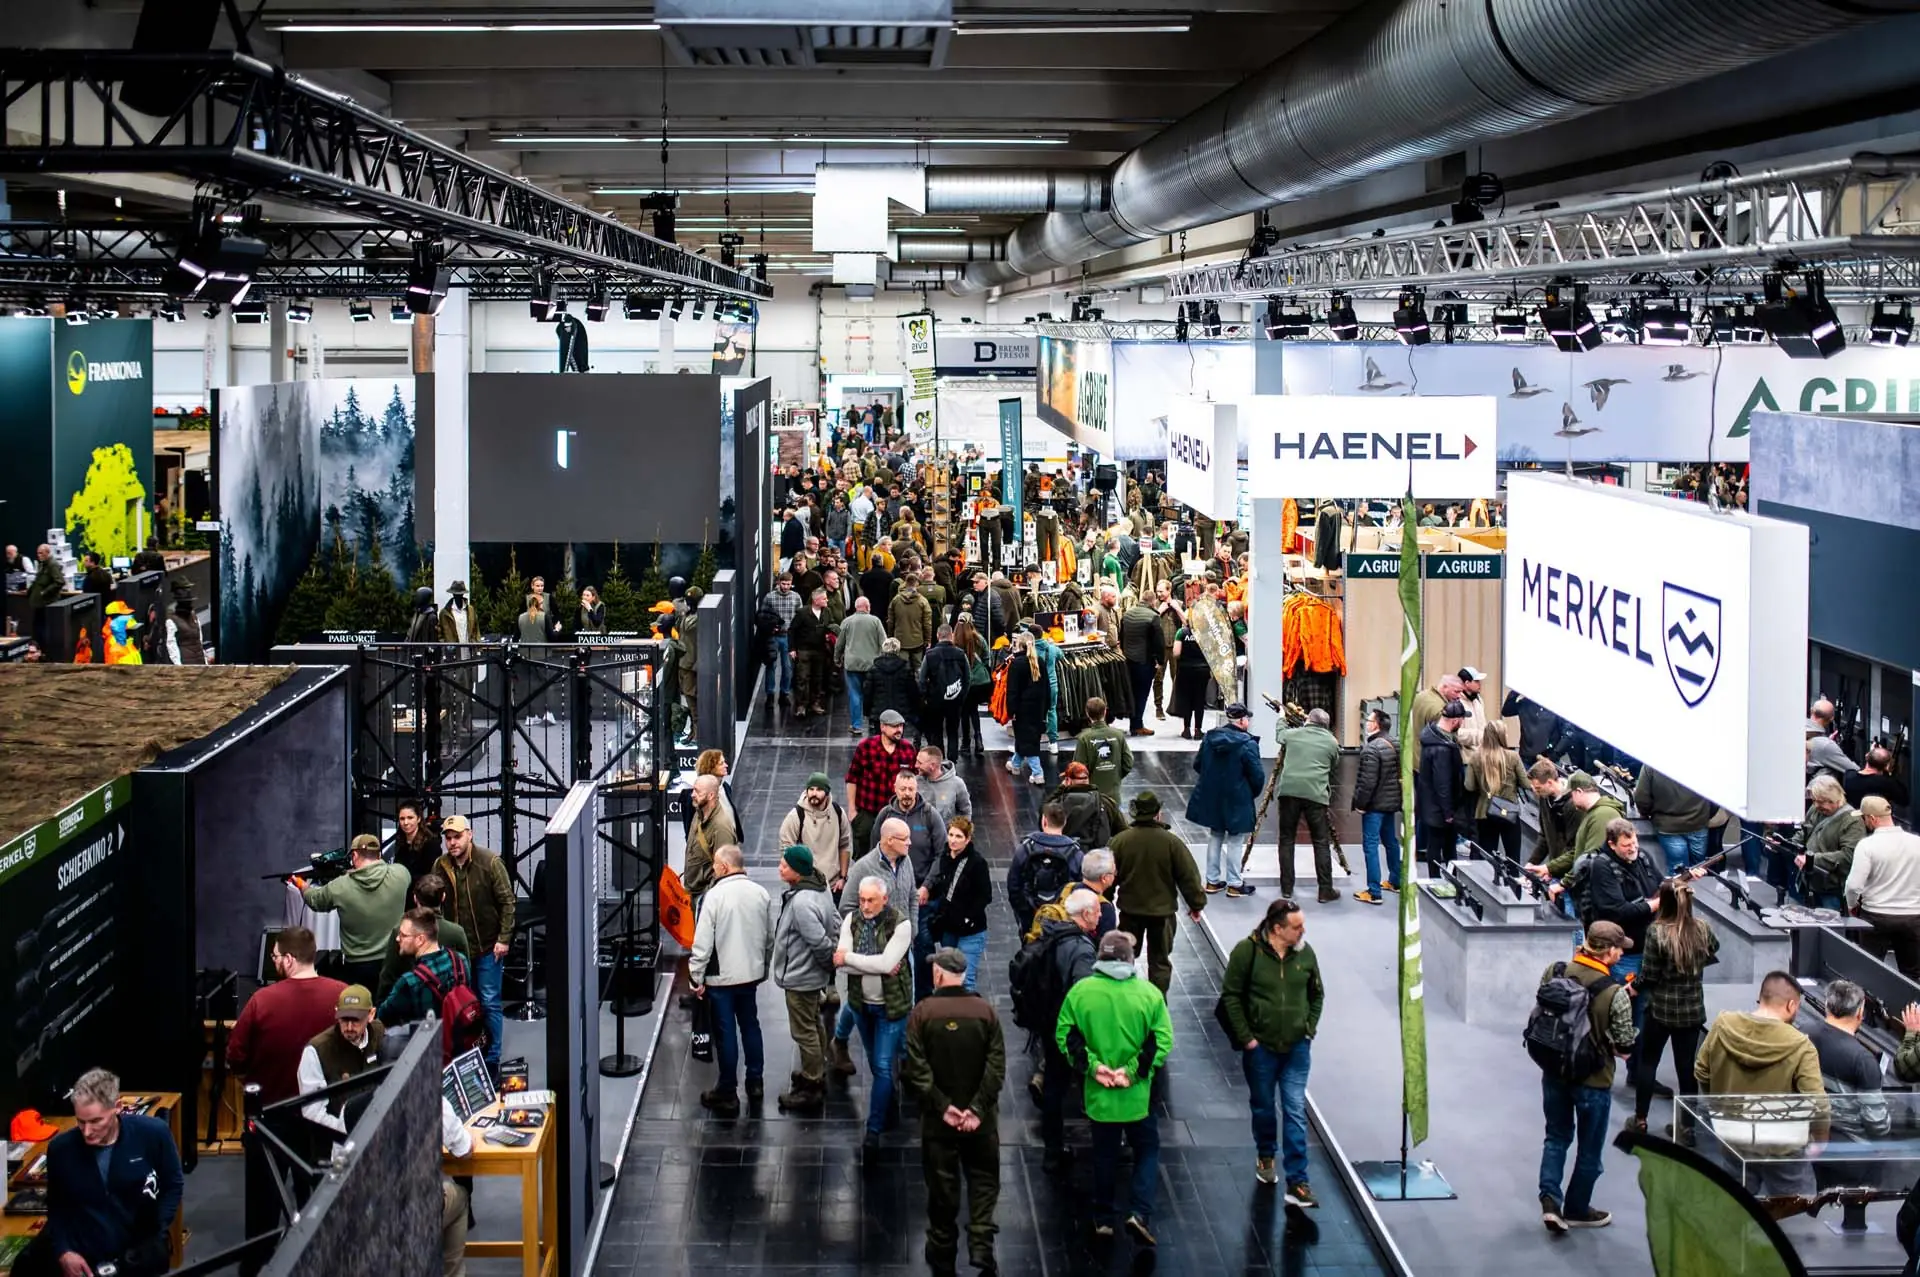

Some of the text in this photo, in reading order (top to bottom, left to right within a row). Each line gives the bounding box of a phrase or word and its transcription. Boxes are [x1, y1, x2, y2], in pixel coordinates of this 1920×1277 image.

[88, 361, 143, 381] FRANKONIA
[1170, 431, 1207, 472] HAENEL
[1274, 432, 1460, 460] HAENEL
[1523, 558, 1654, 667] MERKEL
[328, 634, 376, 643] PARFORCE
[107, 832, 113, 856] 2
[0, 848, 25, 873] ERKEL
